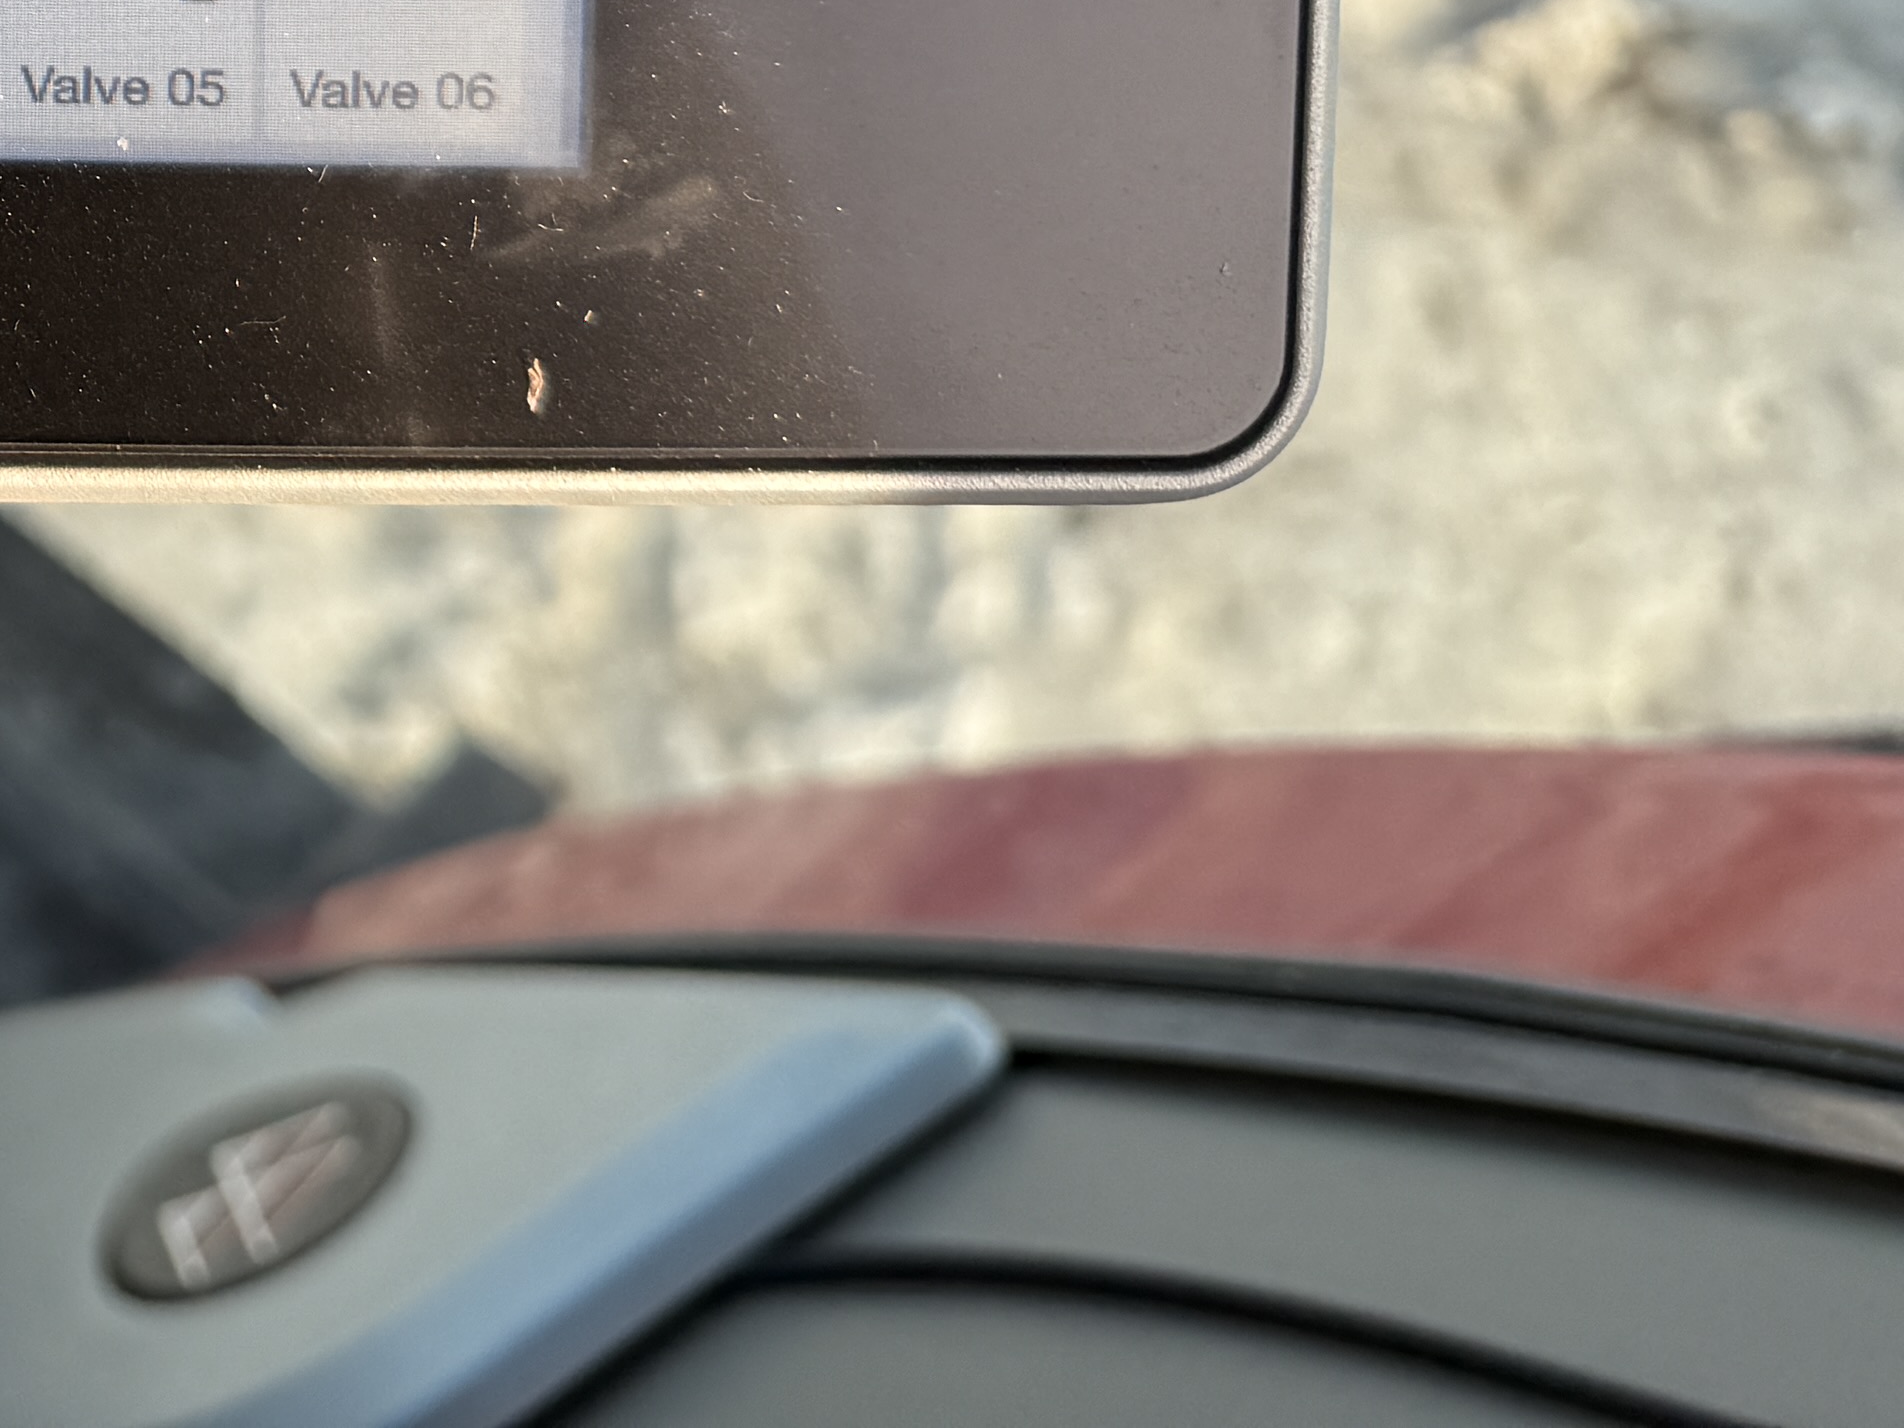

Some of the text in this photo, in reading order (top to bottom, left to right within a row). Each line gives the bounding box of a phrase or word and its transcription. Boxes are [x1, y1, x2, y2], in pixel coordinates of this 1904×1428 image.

[21, 64, 227, 108] Valve 05
[290, 69, 496, 113] Valve 06
